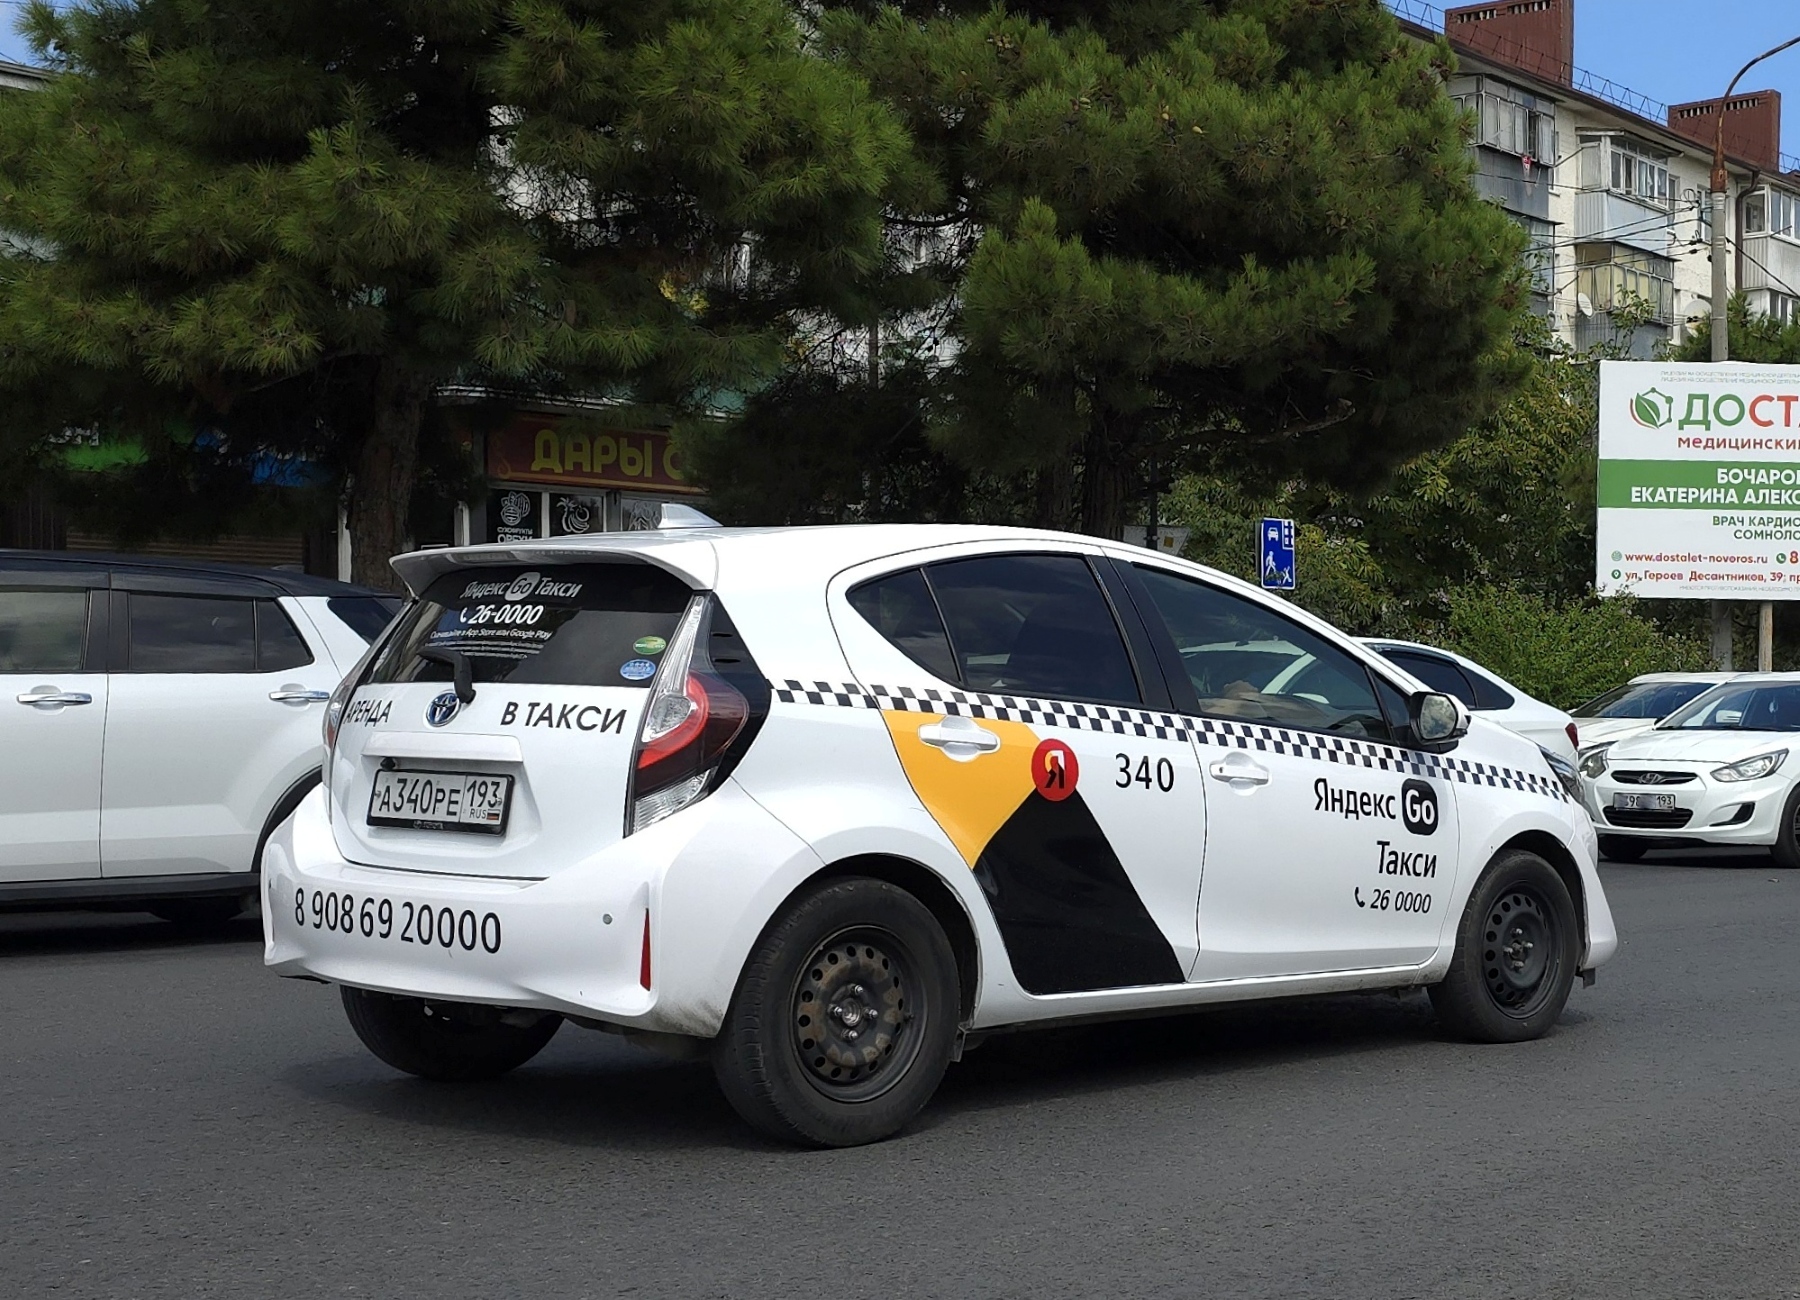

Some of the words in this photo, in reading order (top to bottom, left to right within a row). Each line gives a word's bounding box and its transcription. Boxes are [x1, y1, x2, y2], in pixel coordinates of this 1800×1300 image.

[1678, 393, 1800, 431] ДОСТ
[531, 429, 652, 478] ДАРЫ
[1678, 437, 1800, 451] медицински
[1631, 487, 1738, 504] ЕКАТЕРИНА
[1712, 516, 1744, 527] ВРАЧ
[1625, 553, 1768, 564] www.dostalet-novoros.ru
[460, 579, 509, 599] Яндекс
[511, 577, 532, 596] Go
[535, 576, 583, 598] Такси
[1644, 570, 1683, 581] Героев
[1689, 571, 1766, 583] Десантников,
[468, 604, 544, 624] 26-0000
[465, 628, 479, 637] App
[479, 628, 496, 636] Store
[510, 628, 534, 639] Google
[534, 630, 553, 640] Play
[343, 699, 392, 727] АРЕНДА
[500, 702, 518, 726] В
[524, 702, 627, 735] ТАКСИ
[1115, 752, 1175, 792] 340
[467, 780, 500, 808] 193
[1313, 777, 1396, 820] Яндекс
[1405, 788, 1437, 827] Go
[1656, 795, 1672, 808] 193
[469, 808, 487, 819] RUS
[1376, 841, 1438, 879] Такси
[1370, 889, 1391, 911] 26
[1395, 890, 1431, 914] 0000
[295, 888, 305, 927] 8
[311, 890, 354, 934] 908
[359, 898, 393, 939] 69
[400, 902, 501, 954] 20000
